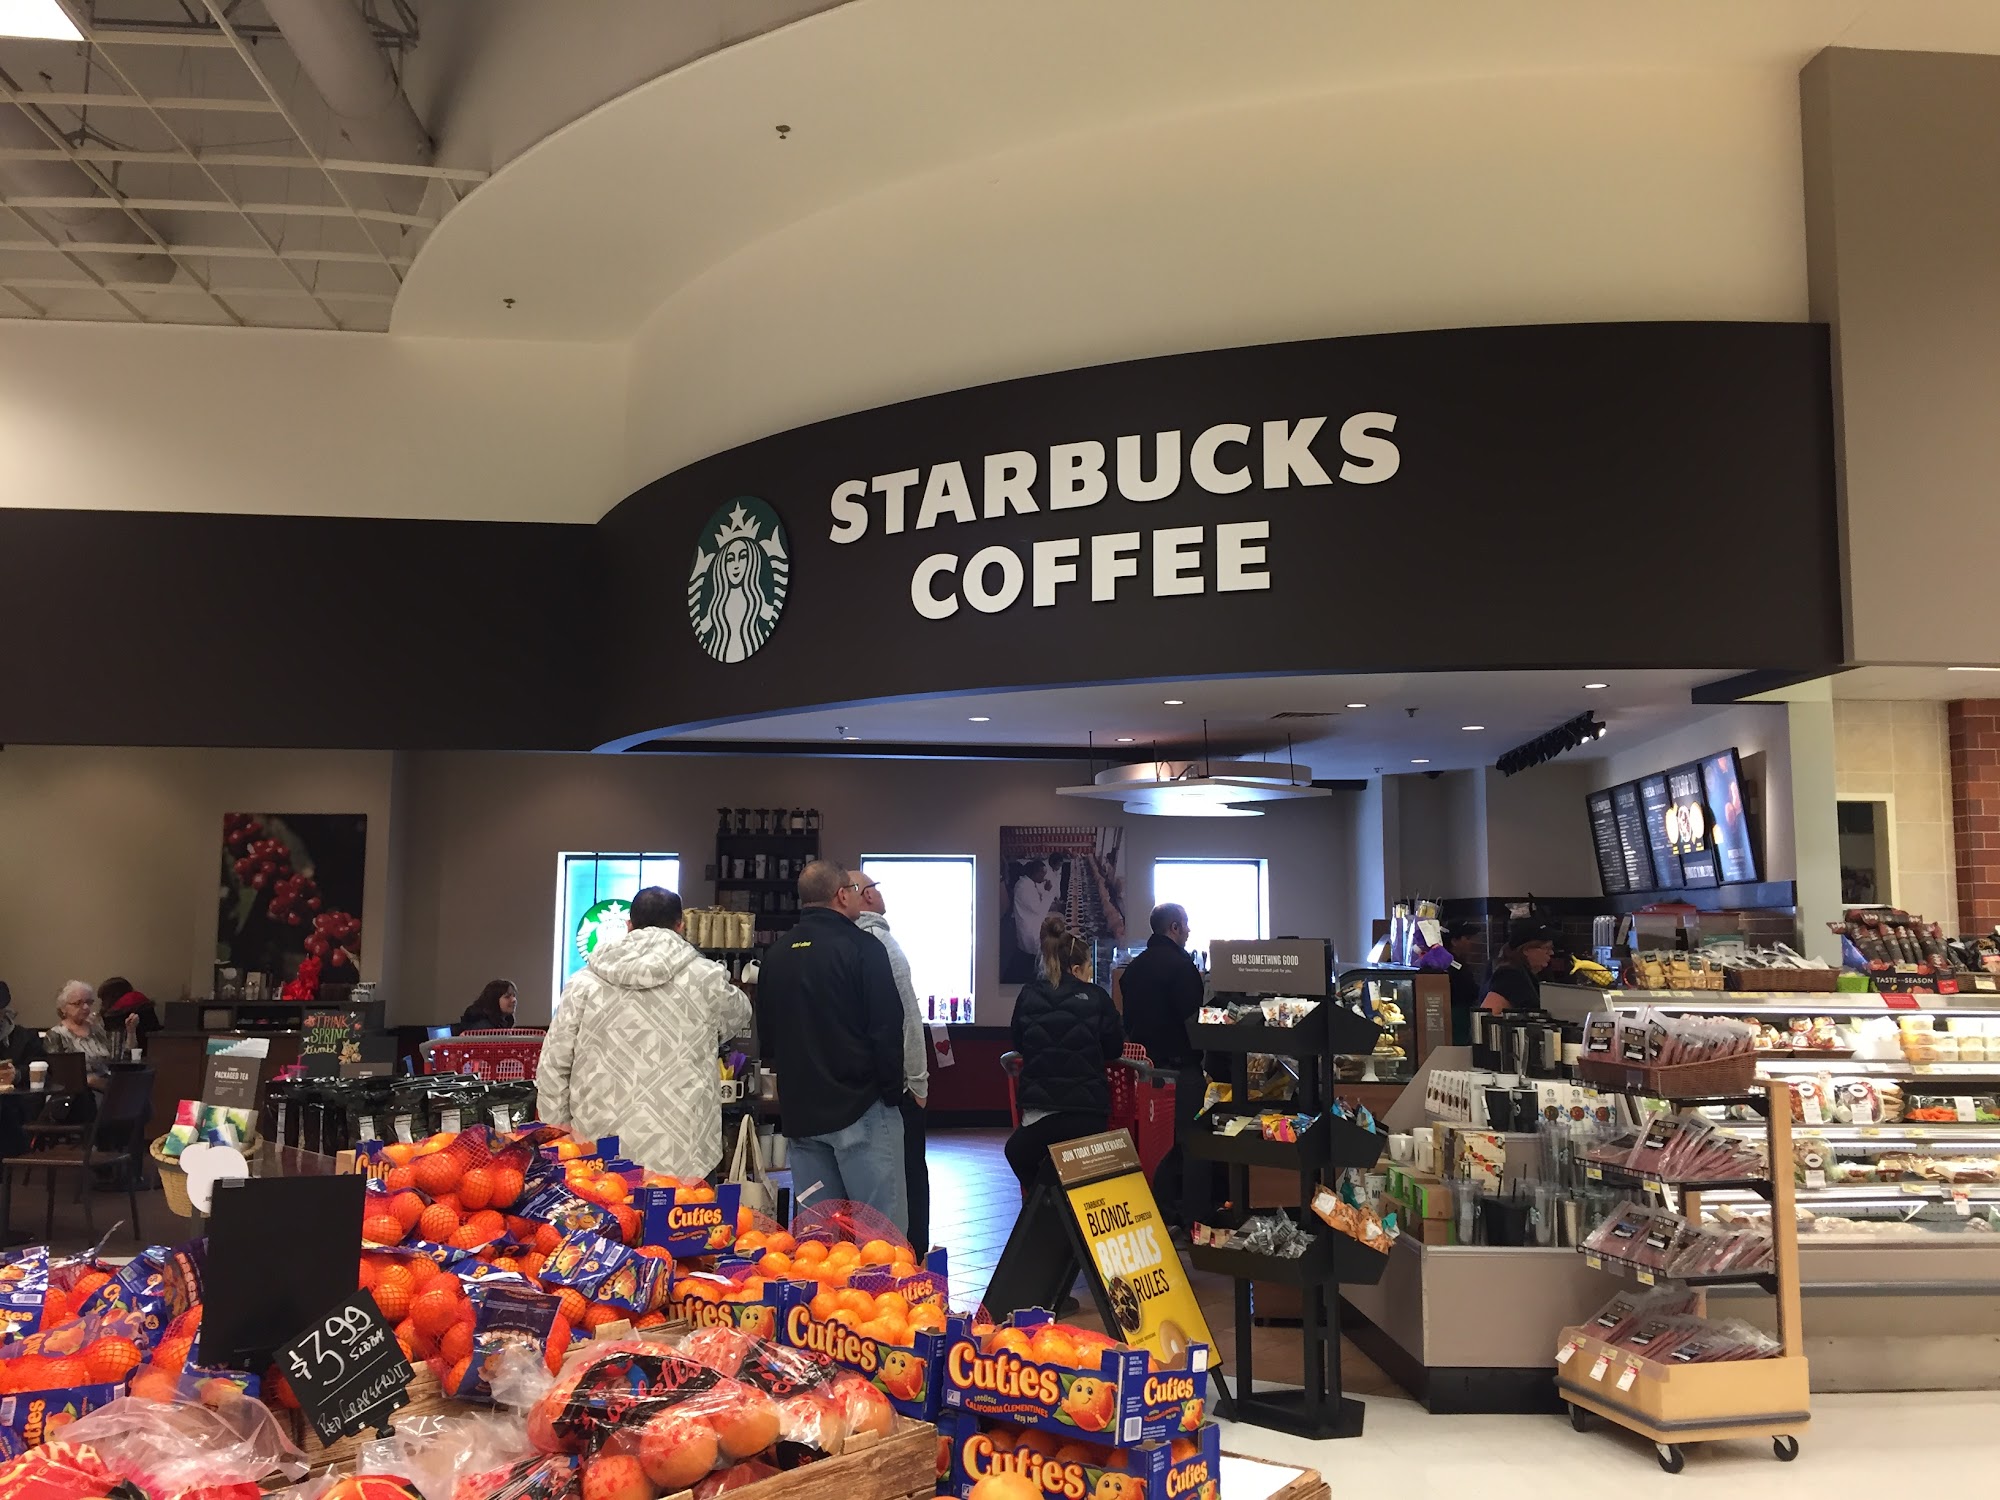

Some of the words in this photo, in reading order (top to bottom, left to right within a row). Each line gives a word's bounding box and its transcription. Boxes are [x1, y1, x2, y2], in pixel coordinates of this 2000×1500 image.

[829, 411, 1400, 545] STARBUCKS
[911, 520, 1270, 620] COFFEE
[1231, 953, 1248, 965] GRAB
[1248, 954, 1282, 966] SOMETHING
[1282, 954, 1299, 966] GOOD
[1875, 976, 1897, 984] TASTE
[214, 1071, 240, 1080] PACKAGED
[240, 1072, 249, 1080] TEA
[1061, 1149, 1076, 1163] JOIN
[1090, 1142, 1106, 1155] EARN
[668, 1206, 722, 1229] Cuties
[1087, 1202, 1134, 1237] BLONDE
[1134, 1211, 1153, 1223] ESPRESSO
[1095, 1225, 1162, 1276] BREAKS
[1133, 1268, 1170, 1303] RULES
[0, 1308, 34, 1322] ties
[787, 1305, 877, 1372] Cuties
[339, 1361, 410, 1420] GRAPEFRUIT
[947, 1341, 1060, 1406] Cuties
[1144, 1376, 1194, 1406] Cuties
[1014, 1413, 1026, 1424] easy
[963, 1434, 1086, 1500] Cuties
[1166, 1460, 1208, 1498] Cuties
